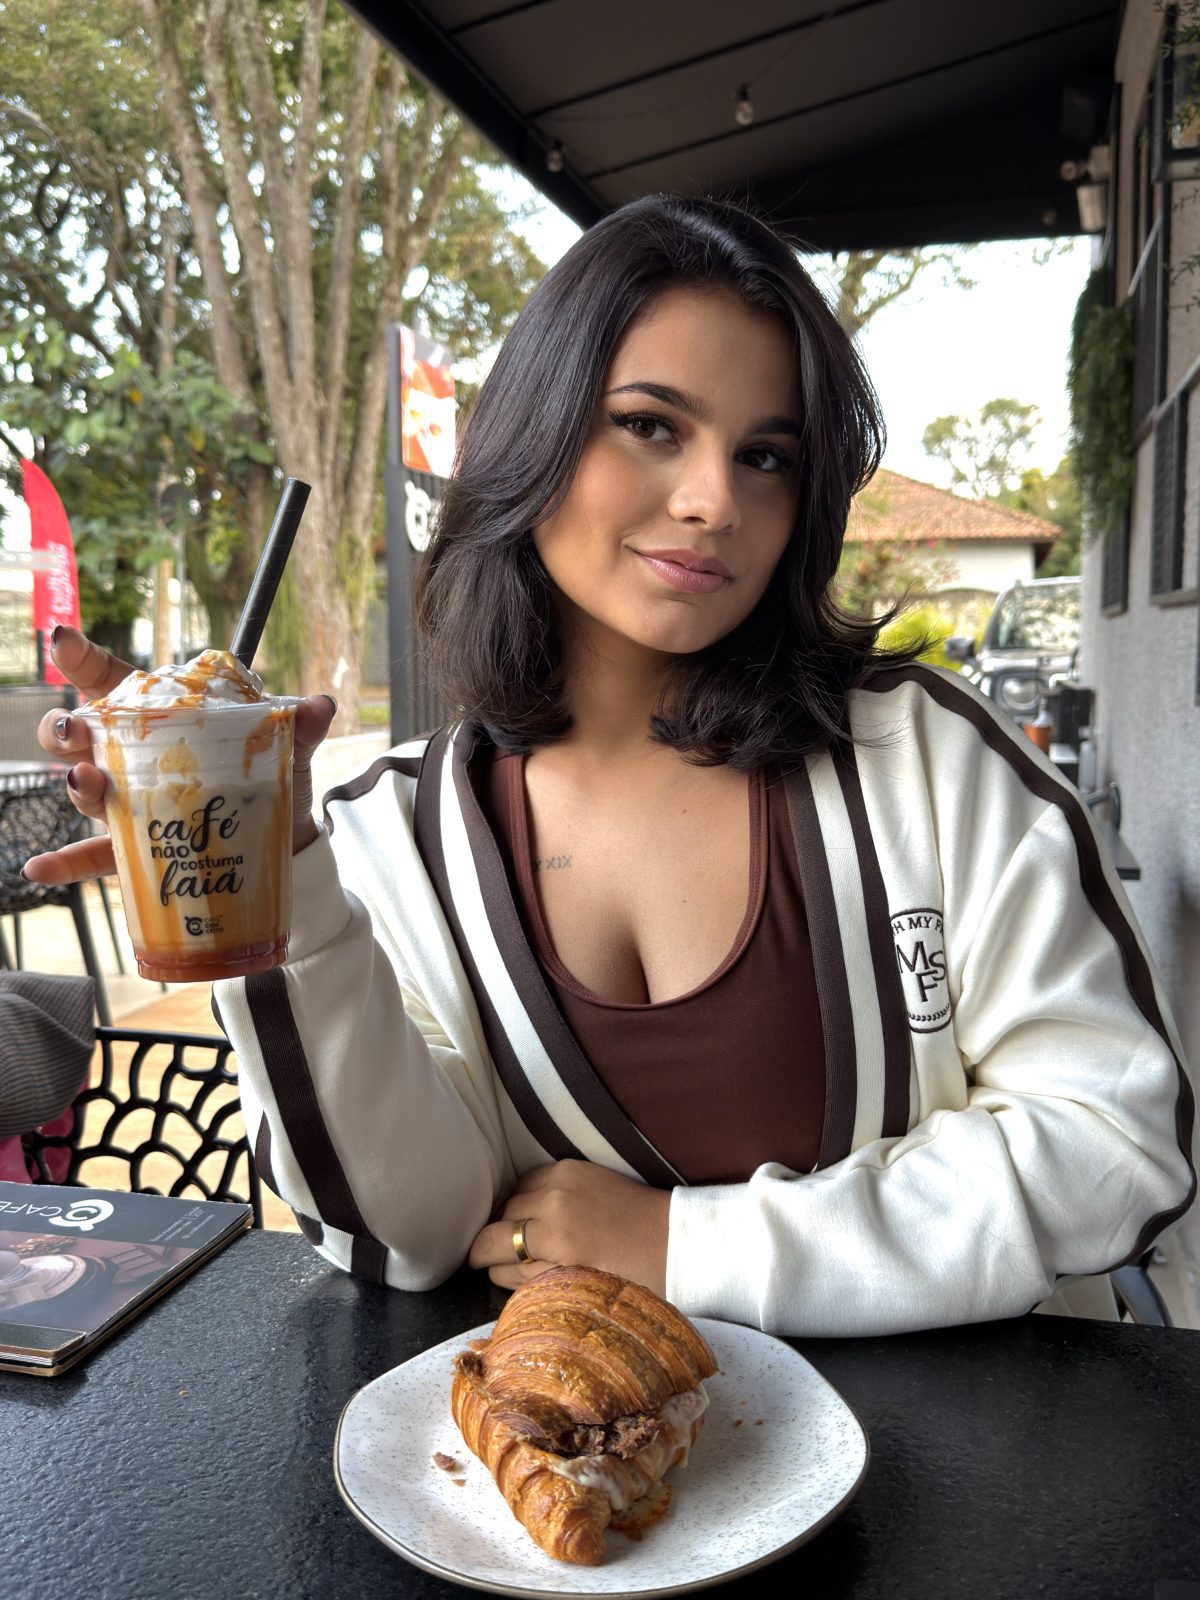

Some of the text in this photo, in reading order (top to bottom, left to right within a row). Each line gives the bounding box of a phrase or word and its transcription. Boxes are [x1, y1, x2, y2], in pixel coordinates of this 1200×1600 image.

[148, 796, 240, 853] café
[151, 841, 190, 859] não
[180, 855, 244, 871] costuma
[160, 860, 244, 907] faiá
[892, 920, 906, 936] H
[907, 916, 933, 929] MY
